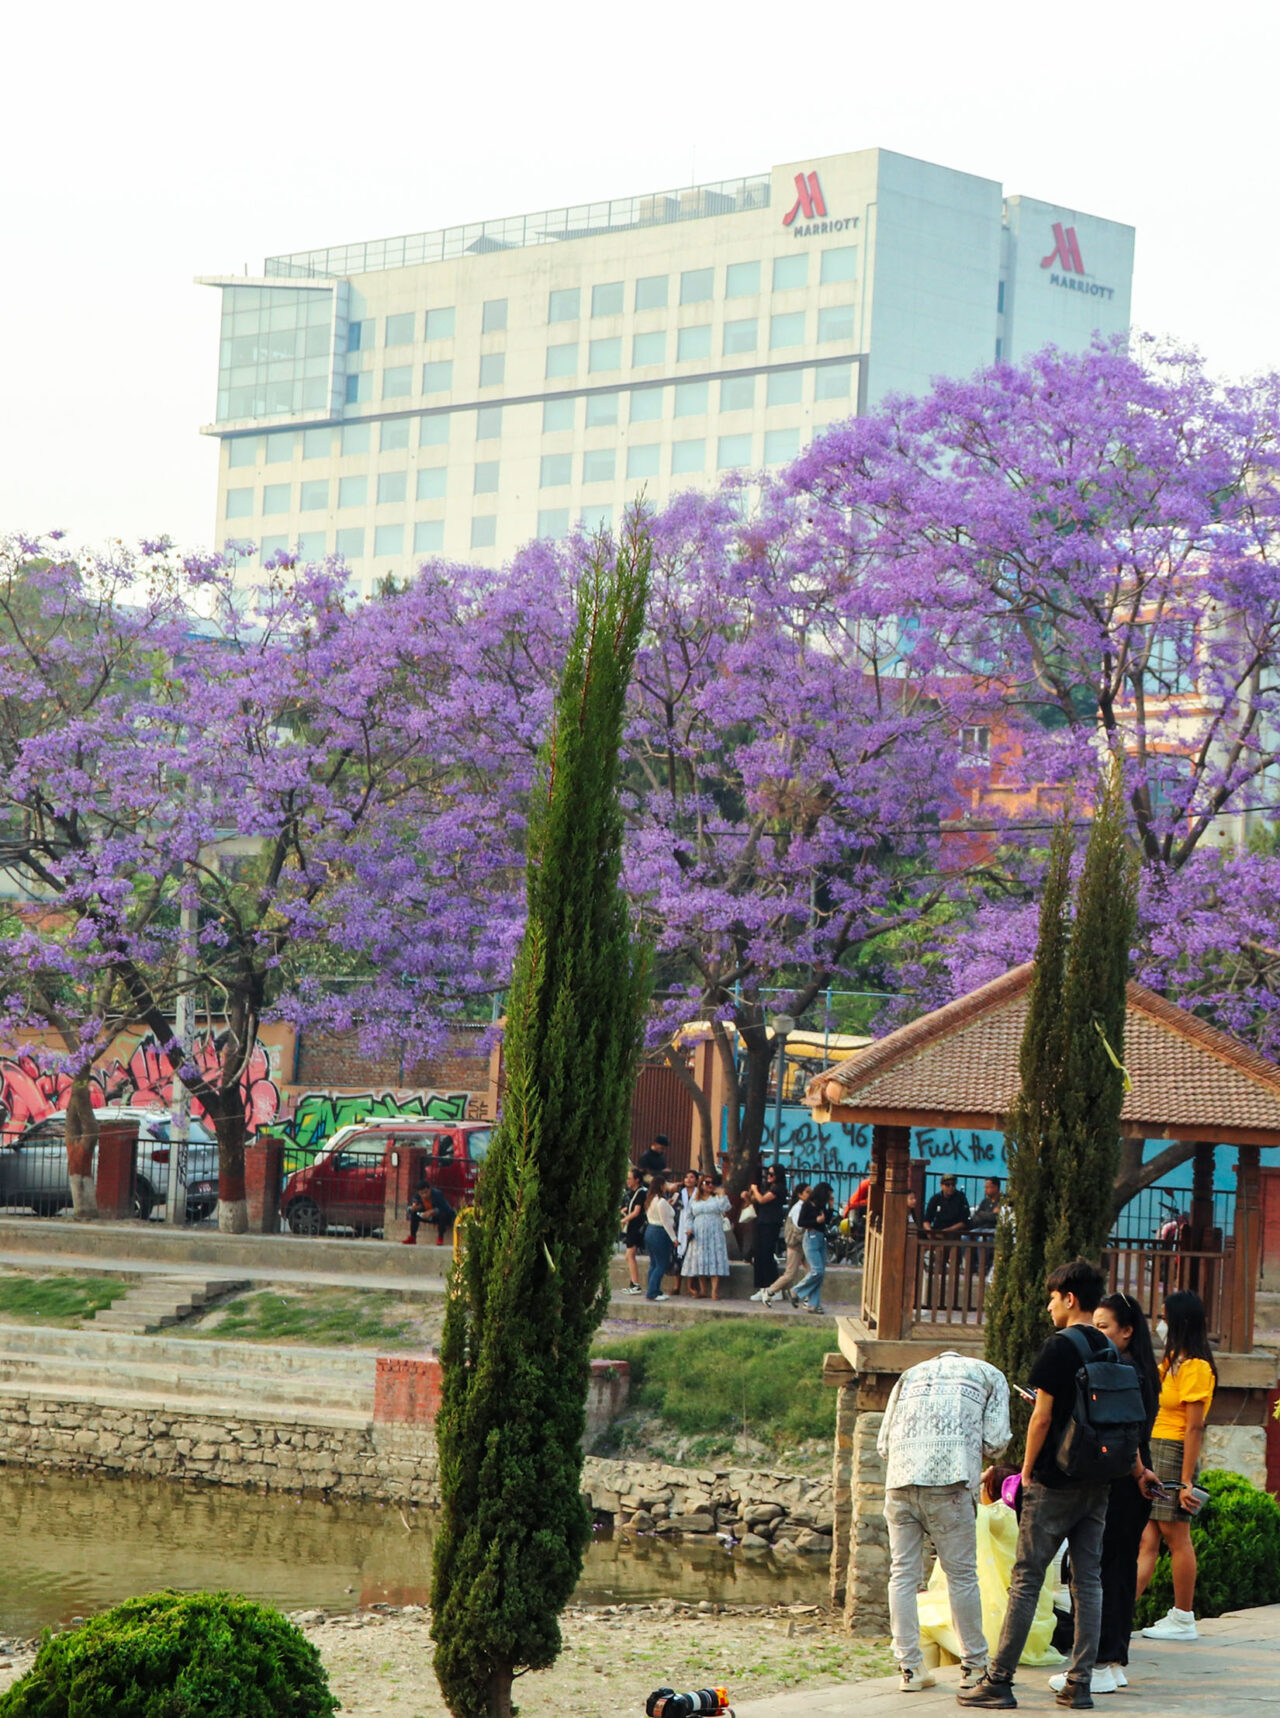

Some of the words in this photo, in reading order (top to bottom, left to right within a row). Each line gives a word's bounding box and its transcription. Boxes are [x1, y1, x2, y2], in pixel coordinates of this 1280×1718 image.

[794, 216, 860, 238] MARRIOTT
[1049, 273, 1115, 300] MARRIOTT
[915, 1127, 969, 1162] Fuck
[968, 1132, 996, 1164] the
